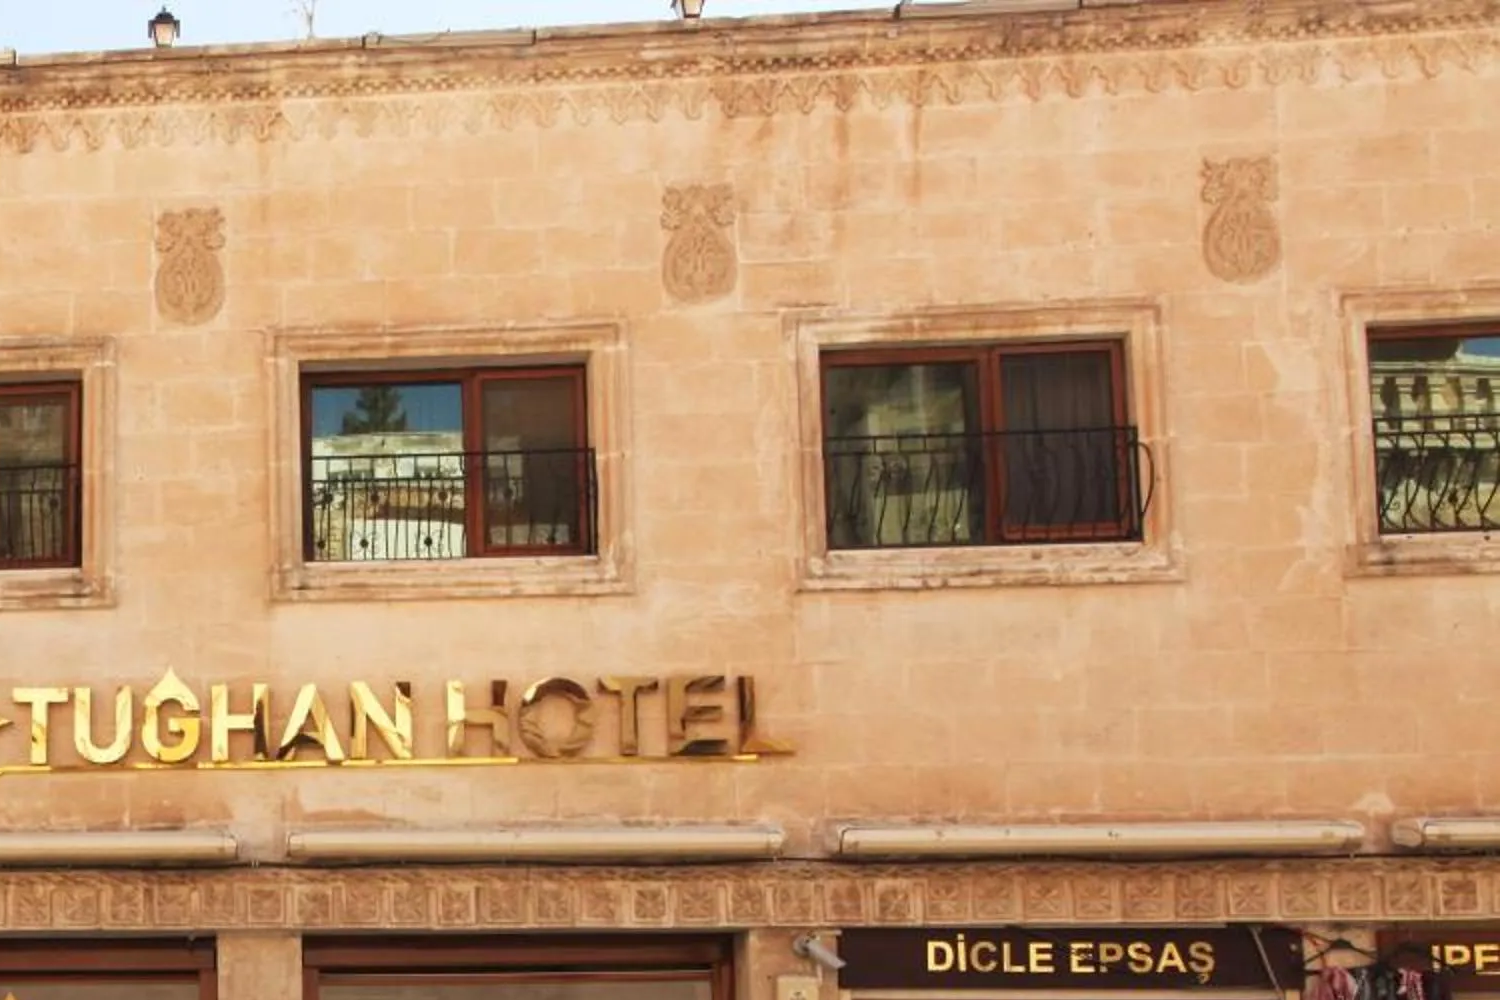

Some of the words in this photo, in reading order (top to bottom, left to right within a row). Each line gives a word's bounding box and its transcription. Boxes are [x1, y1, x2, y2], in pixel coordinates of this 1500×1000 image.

[445, 675, 797, 758] HOTEL
[927, 933, 1055, 973] DİCLE
[1070, 941, 1215, 984] EPSAŞ
